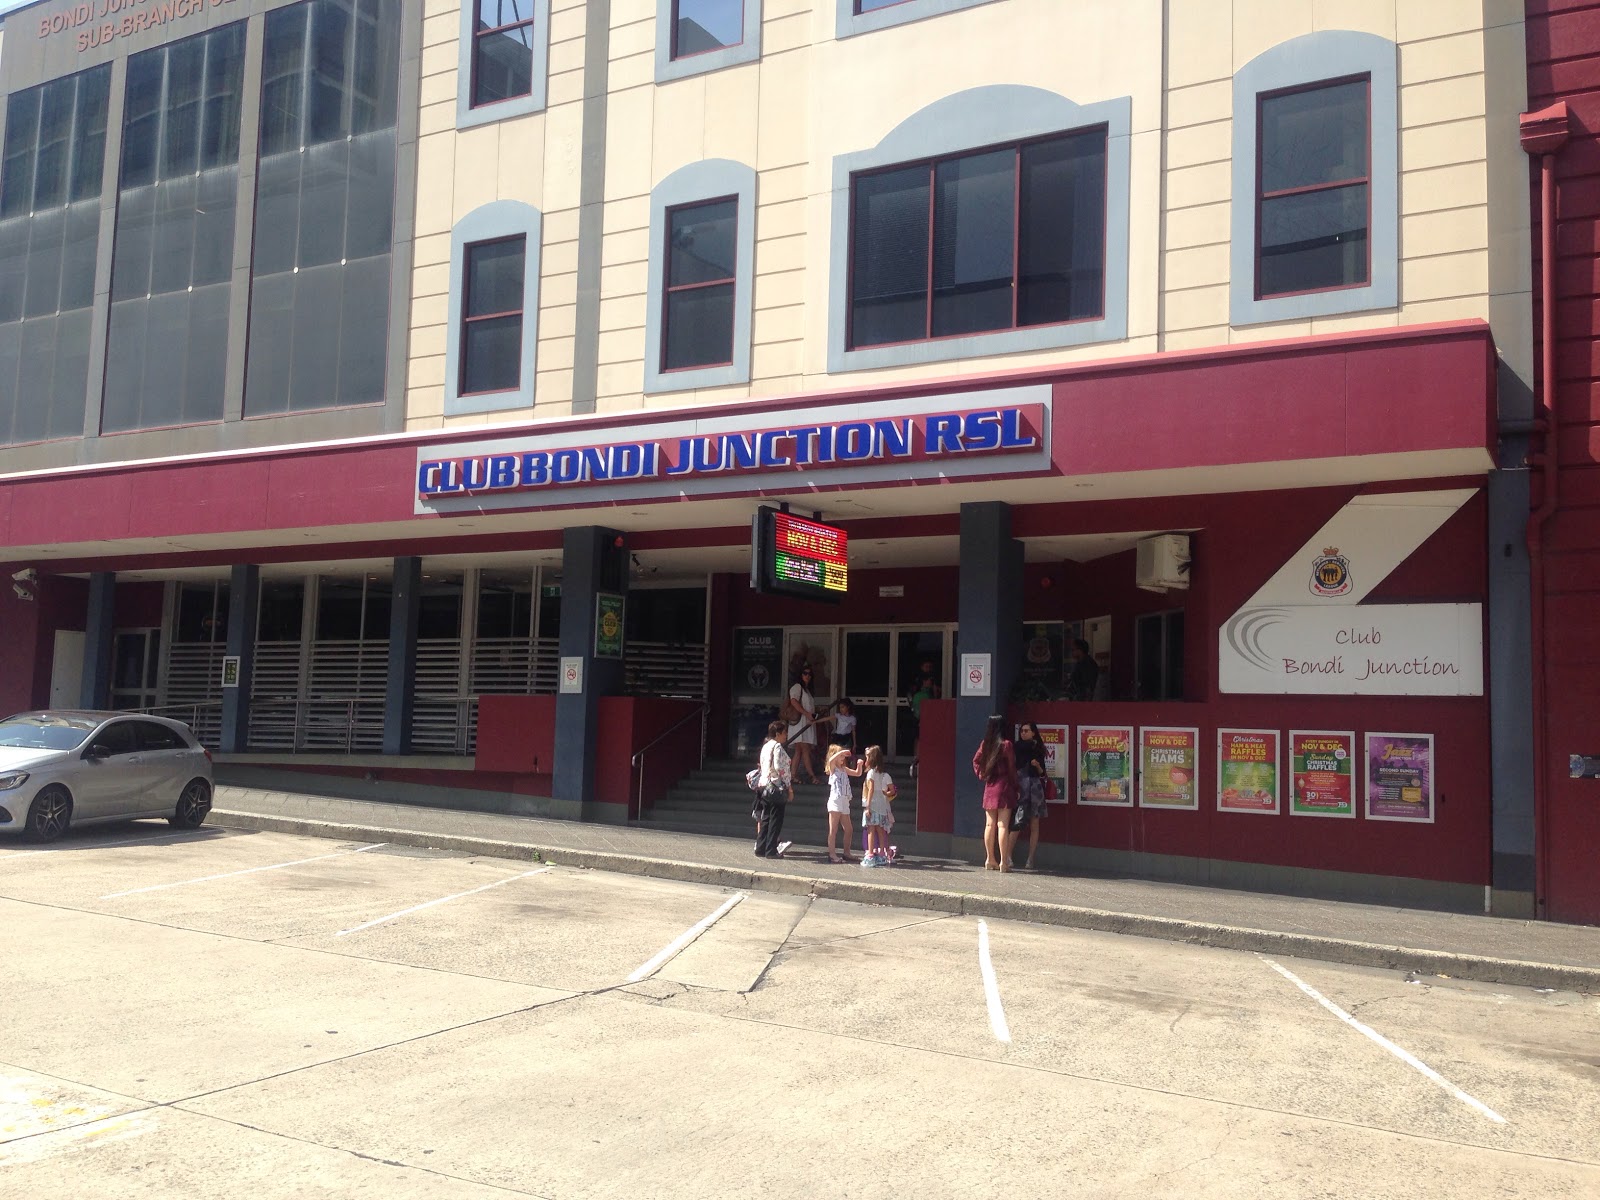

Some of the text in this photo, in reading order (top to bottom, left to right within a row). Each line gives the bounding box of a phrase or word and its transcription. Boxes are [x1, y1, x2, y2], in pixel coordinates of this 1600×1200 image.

[38, 4, 94, 38] BONDI
[76, 0, 203, 52] SUB-BRANCH
[666, 417, 914, 474] JUNCTION
[924, 408, 1037, 455] RSL
[748, 636, 772, 645] CLUB
[1335, 626, 1382, 645] Club
[1282, 656, 1459, 681] Bondi Junction
[1086, 736, 1119, 745] GIANT
[1150, 753, 1185, 763] HAMS
[1230, 748, 1266, 756] RAFFLES
